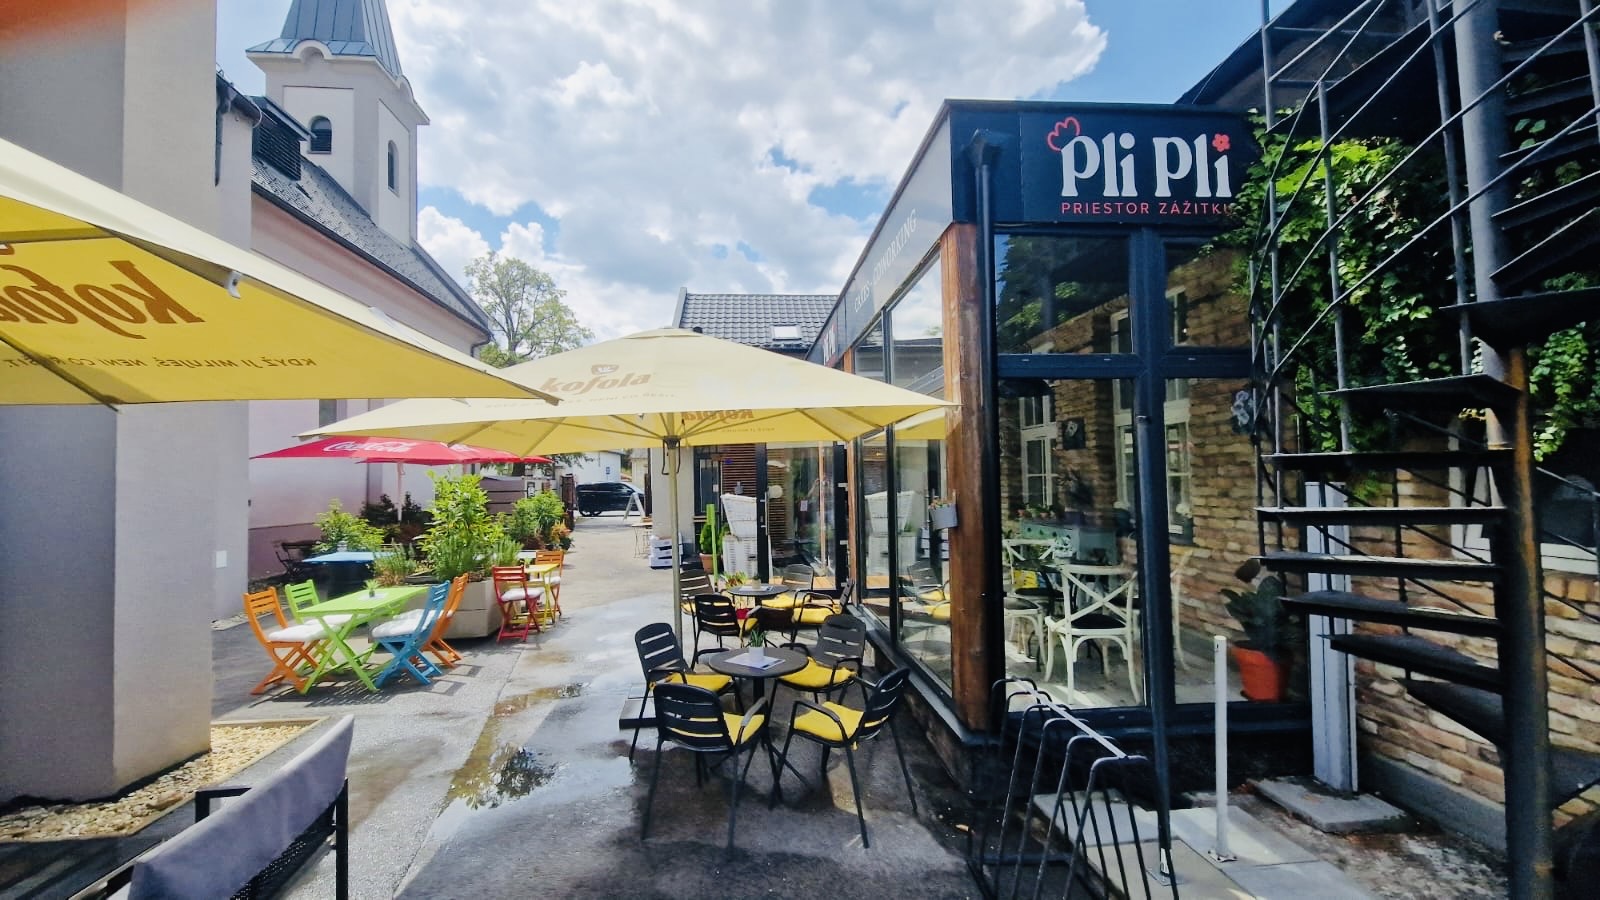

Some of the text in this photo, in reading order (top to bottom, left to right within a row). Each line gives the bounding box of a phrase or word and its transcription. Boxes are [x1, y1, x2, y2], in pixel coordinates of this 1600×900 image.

[1061, 202, 1149, 214] PRIESTOR
[872, 208, 918, 287] COWORKING
[540, 373, 652, 396] kofola
